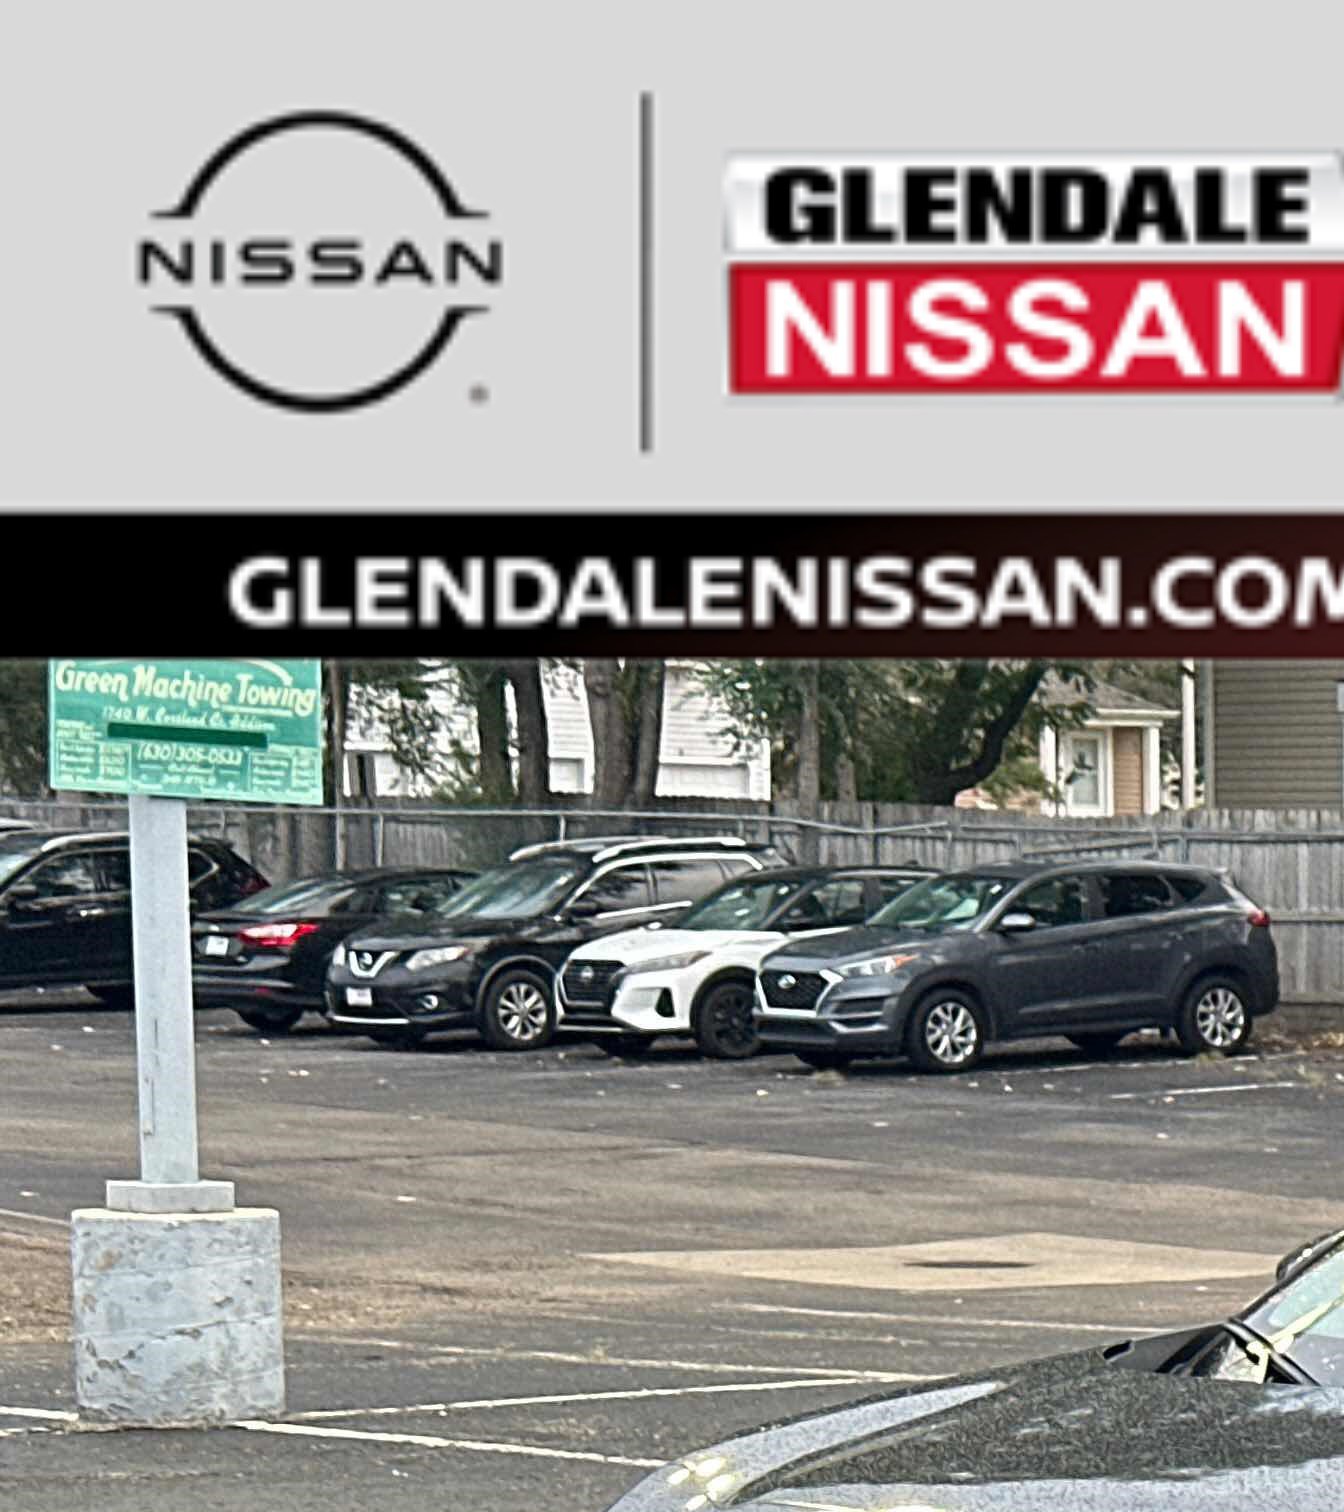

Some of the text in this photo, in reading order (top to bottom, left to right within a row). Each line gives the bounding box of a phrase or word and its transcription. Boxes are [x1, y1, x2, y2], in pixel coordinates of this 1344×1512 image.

[56, 659, 316, 717] Green Machine Towing
